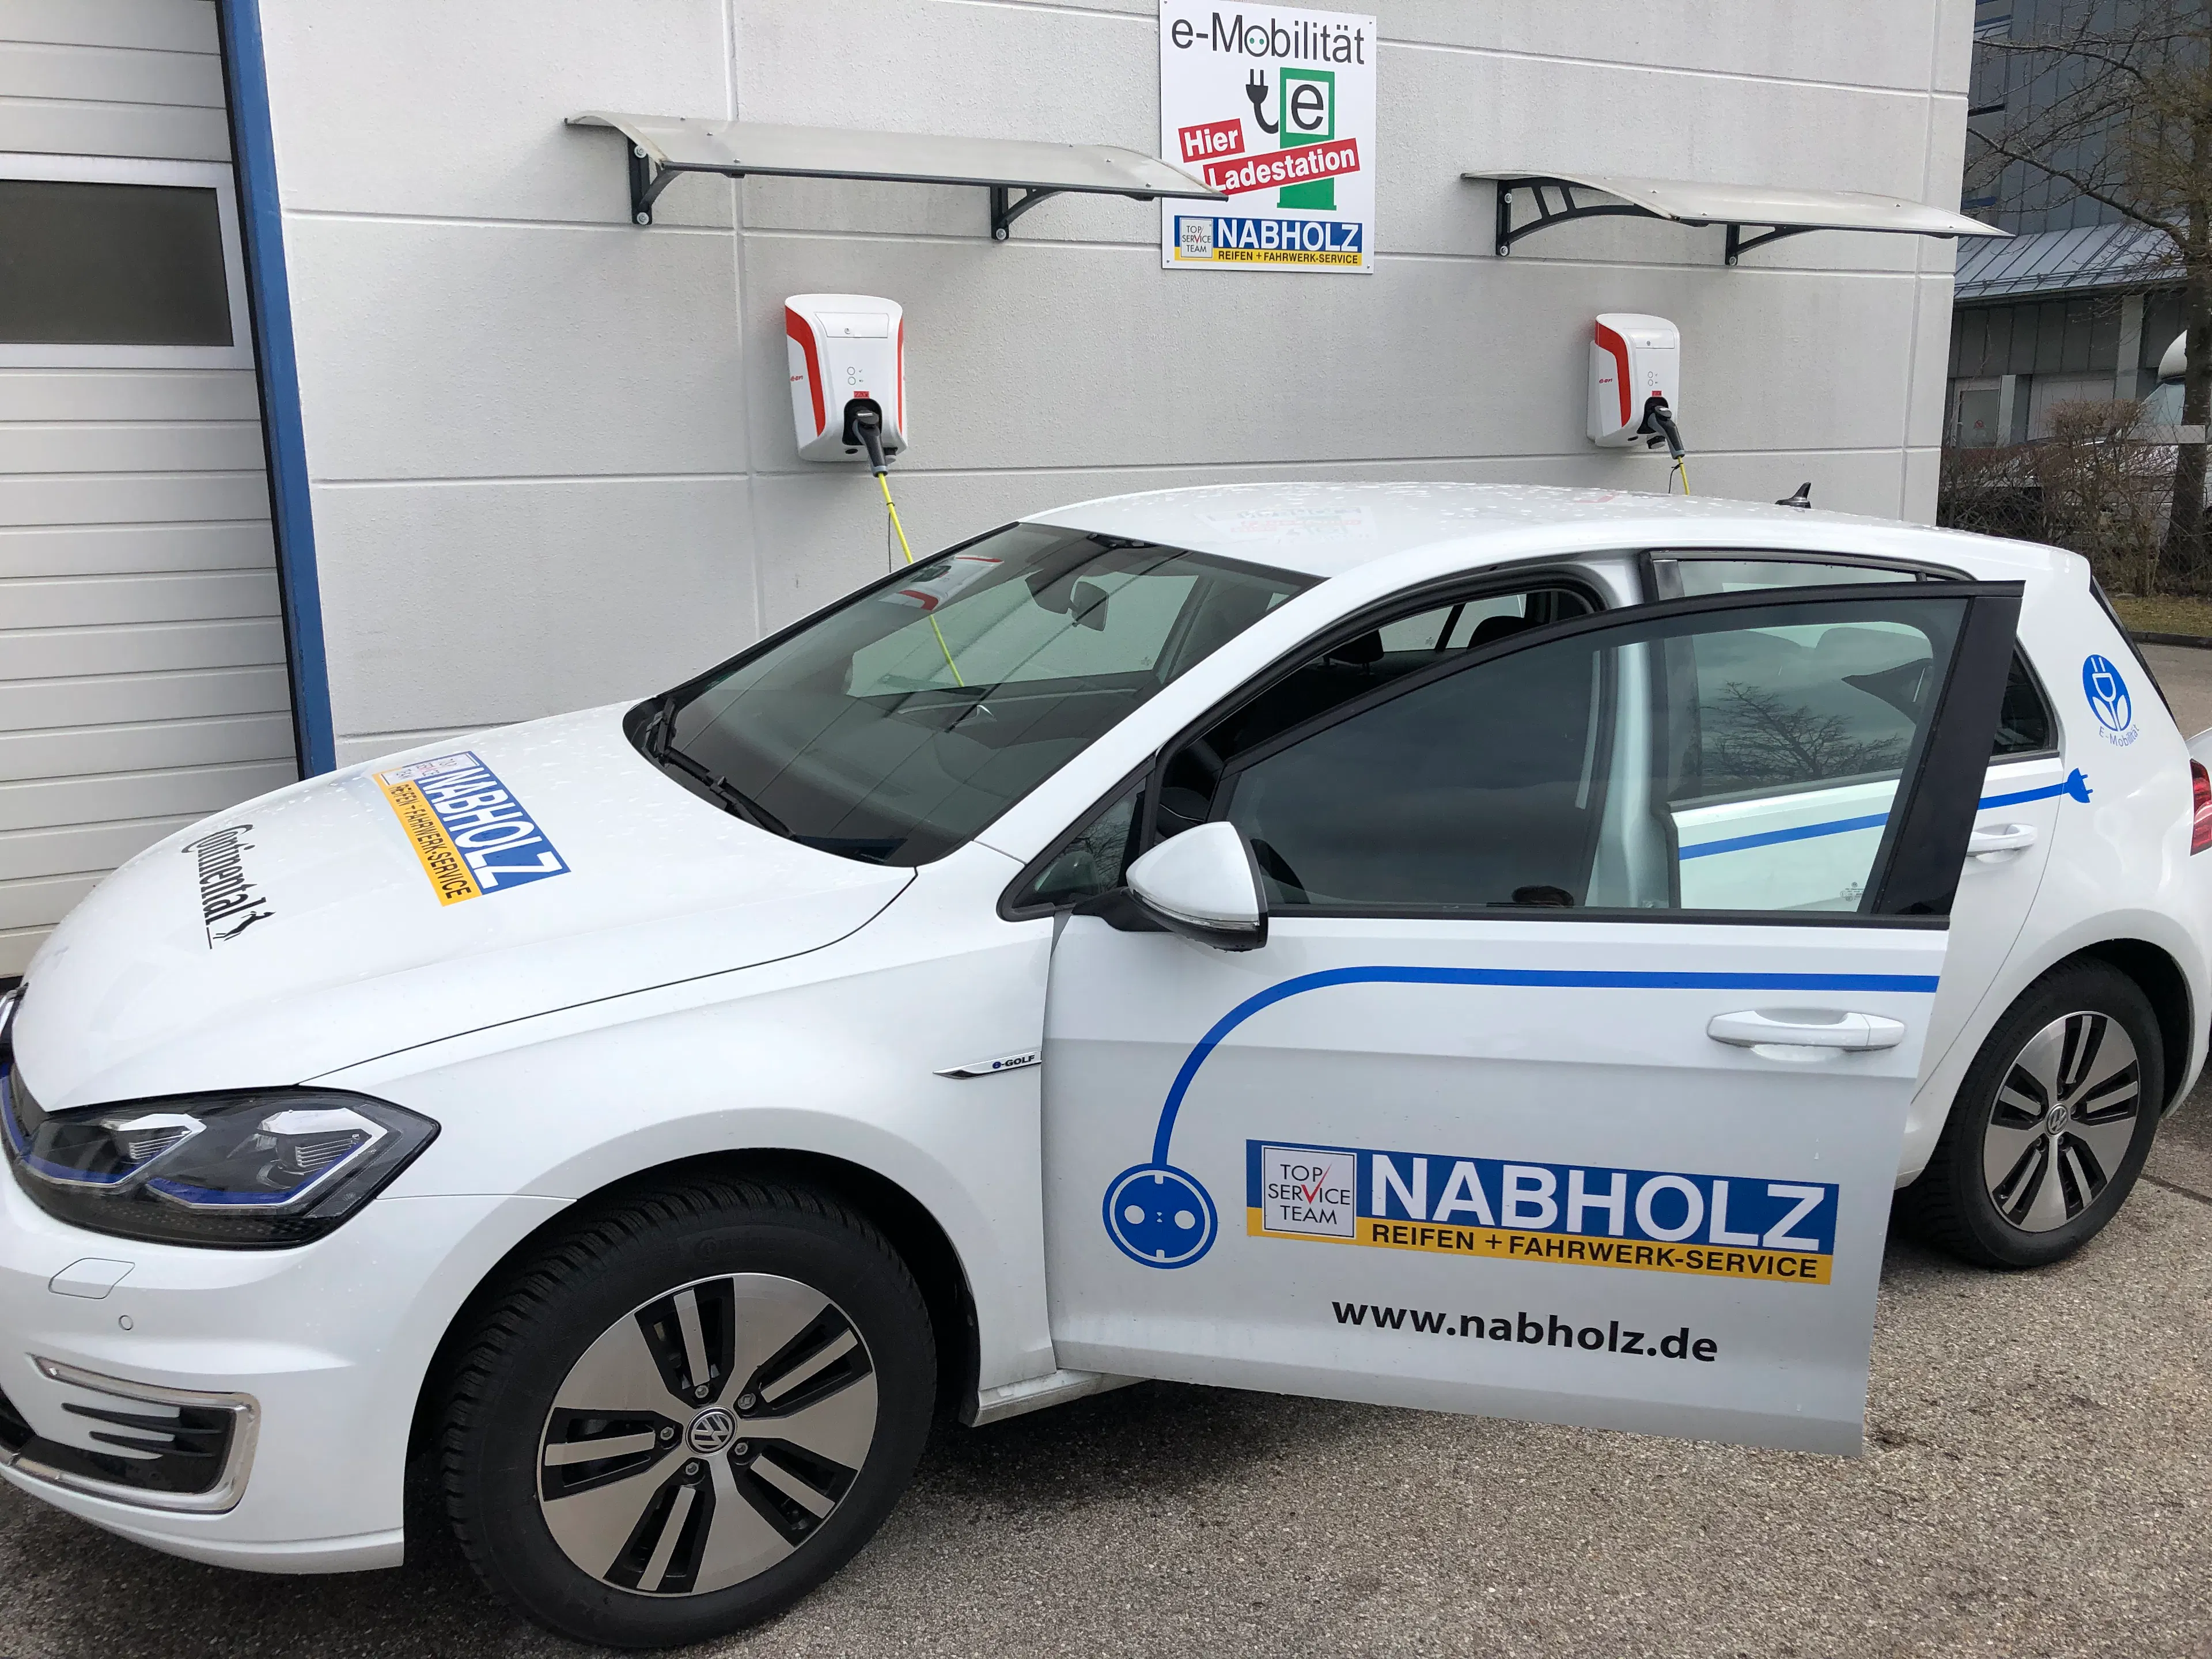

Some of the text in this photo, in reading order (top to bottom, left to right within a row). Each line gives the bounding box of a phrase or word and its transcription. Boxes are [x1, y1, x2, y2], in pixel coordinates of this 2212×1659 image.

[1172, 12, 1365, 65] e-Mobilität
[1291, 84, 1324, 131] e
[1184, 128, 1238, 158] Hier
[1208, 147, 1355, 192] Ladestation
[1182, 234, 1211, 243] SERVICE
[1186, 225, 1202, 233] TOP
[1218, 219, 1360, 252] NABHOLZ
[1186, 245, 1207, 253] TEAM
[1218, 251, 1253, 262] REIFEN
[1263, 252, 1358, 264] FAHRWERK-SERVICE
[2099, 724, 2140, 747] E-Mobilität
[388, 784, 420, 806] REIFEN
[404, 808, 472, 899] FAHRWERK-SERVICE
[417, 763, 562, 889] NABHOLZ
[181, 824, 267, 926] Continental
[991, 1054, 1035, 1069] e-GOLF
[1279, 1163, 1323, 1182] TOP
[1267, 1183, 1351, 1206] SERVICE
[1371, 1154, 1826, 1251] NABHOLZ
[1279, 1205, 1338, 1225] TEAM
[1372, 1223, 1475, 1251] REIFEN
[1508, 1235, 1819, 1279] FAHRWERK-SERVICE
[1332, 1300, 1718, 1363] www.nabholz.de
